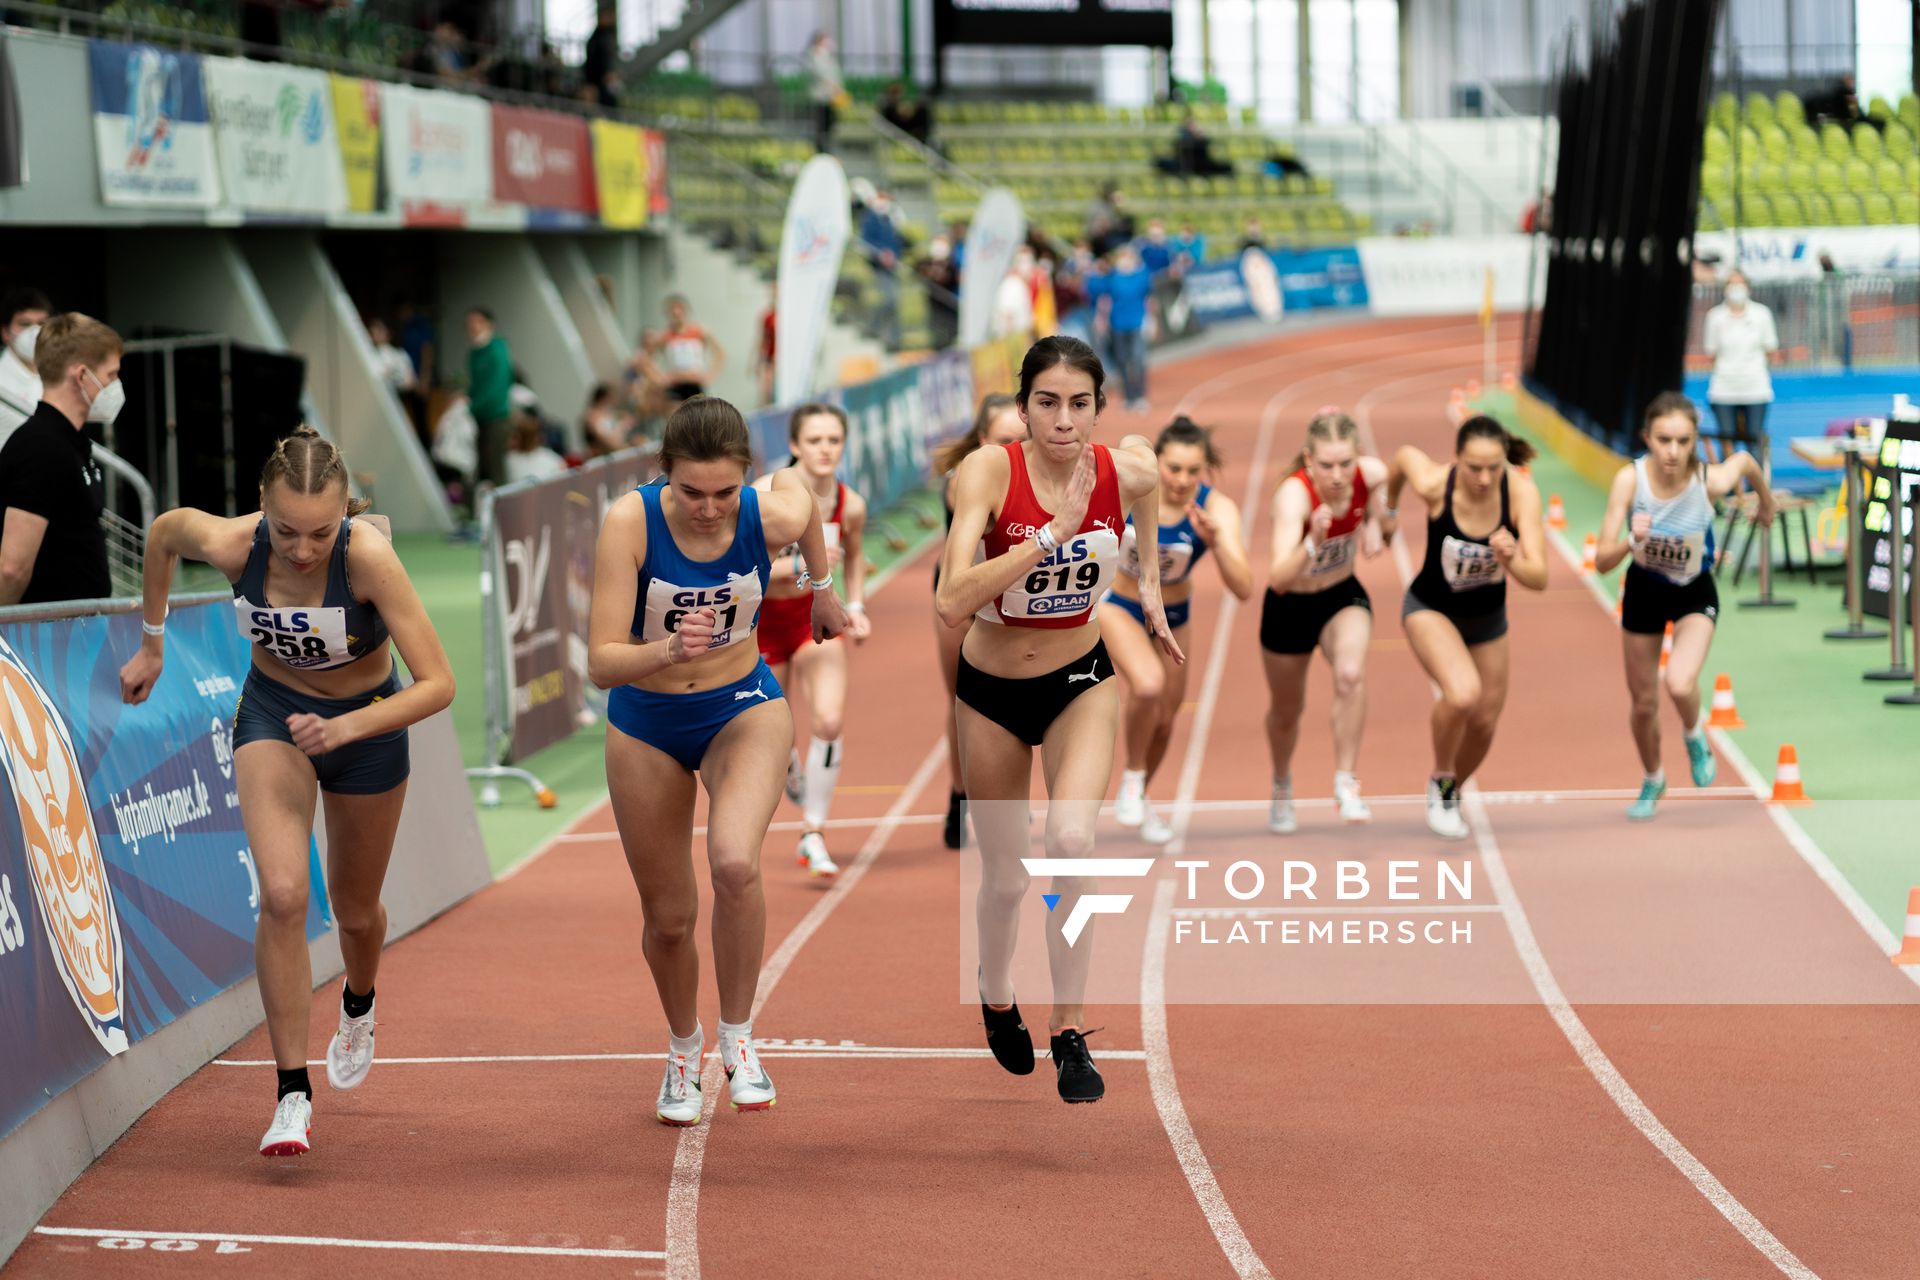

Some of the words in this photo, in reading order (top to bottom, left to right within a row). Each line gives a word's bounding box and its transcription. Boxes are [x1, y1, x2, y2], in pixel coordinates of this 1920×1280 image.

[1025, 562, 1100, 594] 619
[1054, 596, 1088, 607] PLAN
[664, 604, 737, 634] 61
[250, 628, 330, 658] 258
[110, 768, 212, 855] bigfamilygames.de
[97, 1238, 252, 1254] 100
